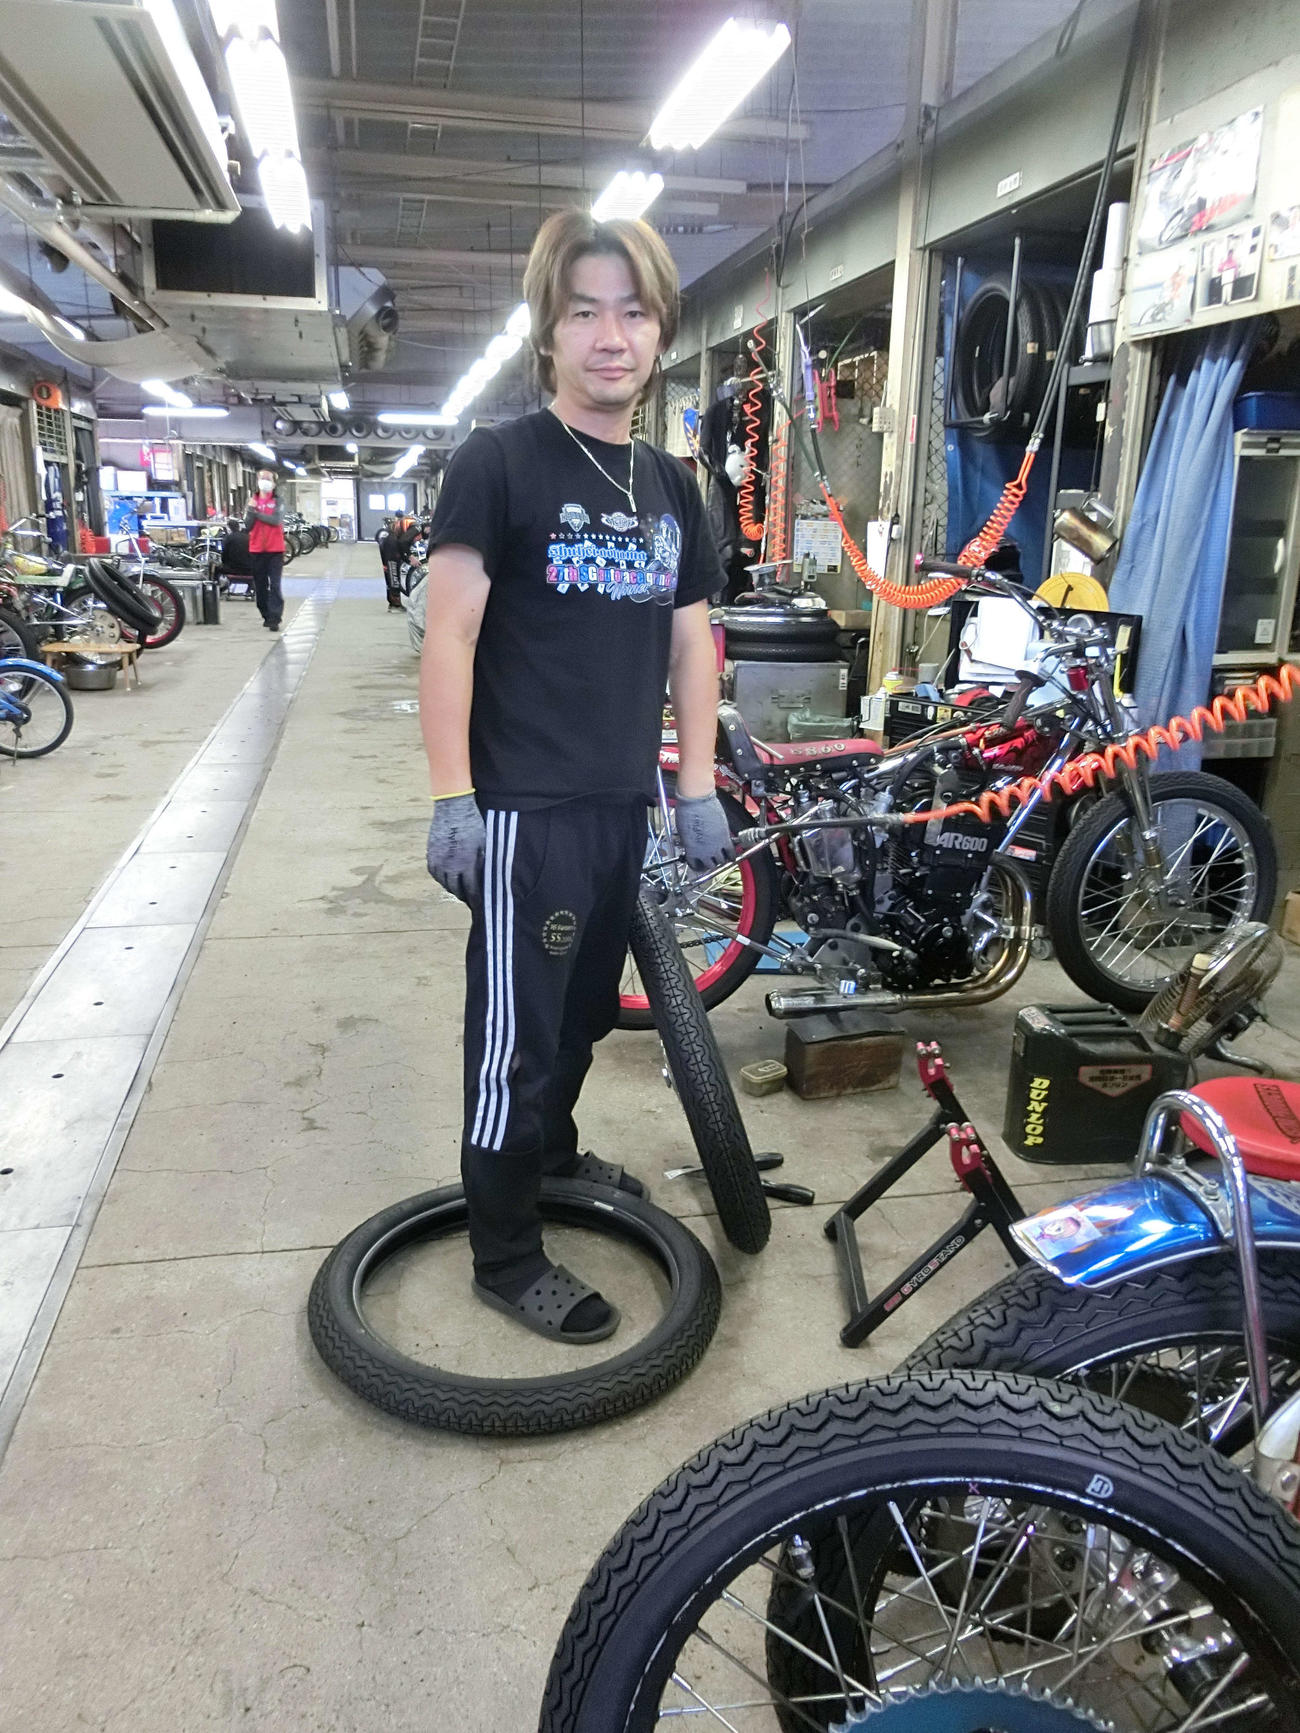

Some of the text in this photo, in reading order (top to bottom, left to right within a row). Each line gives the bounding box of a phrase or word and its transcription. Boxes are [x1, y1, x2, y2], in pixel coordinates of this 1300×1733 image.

[548, 565, 578, 582] 27th
[938, 831, 988, 852] AR600
[1024, 1077, 1050, 1146] DUNLOP
[901, 1235, 965, 1295] GYROSTAND
